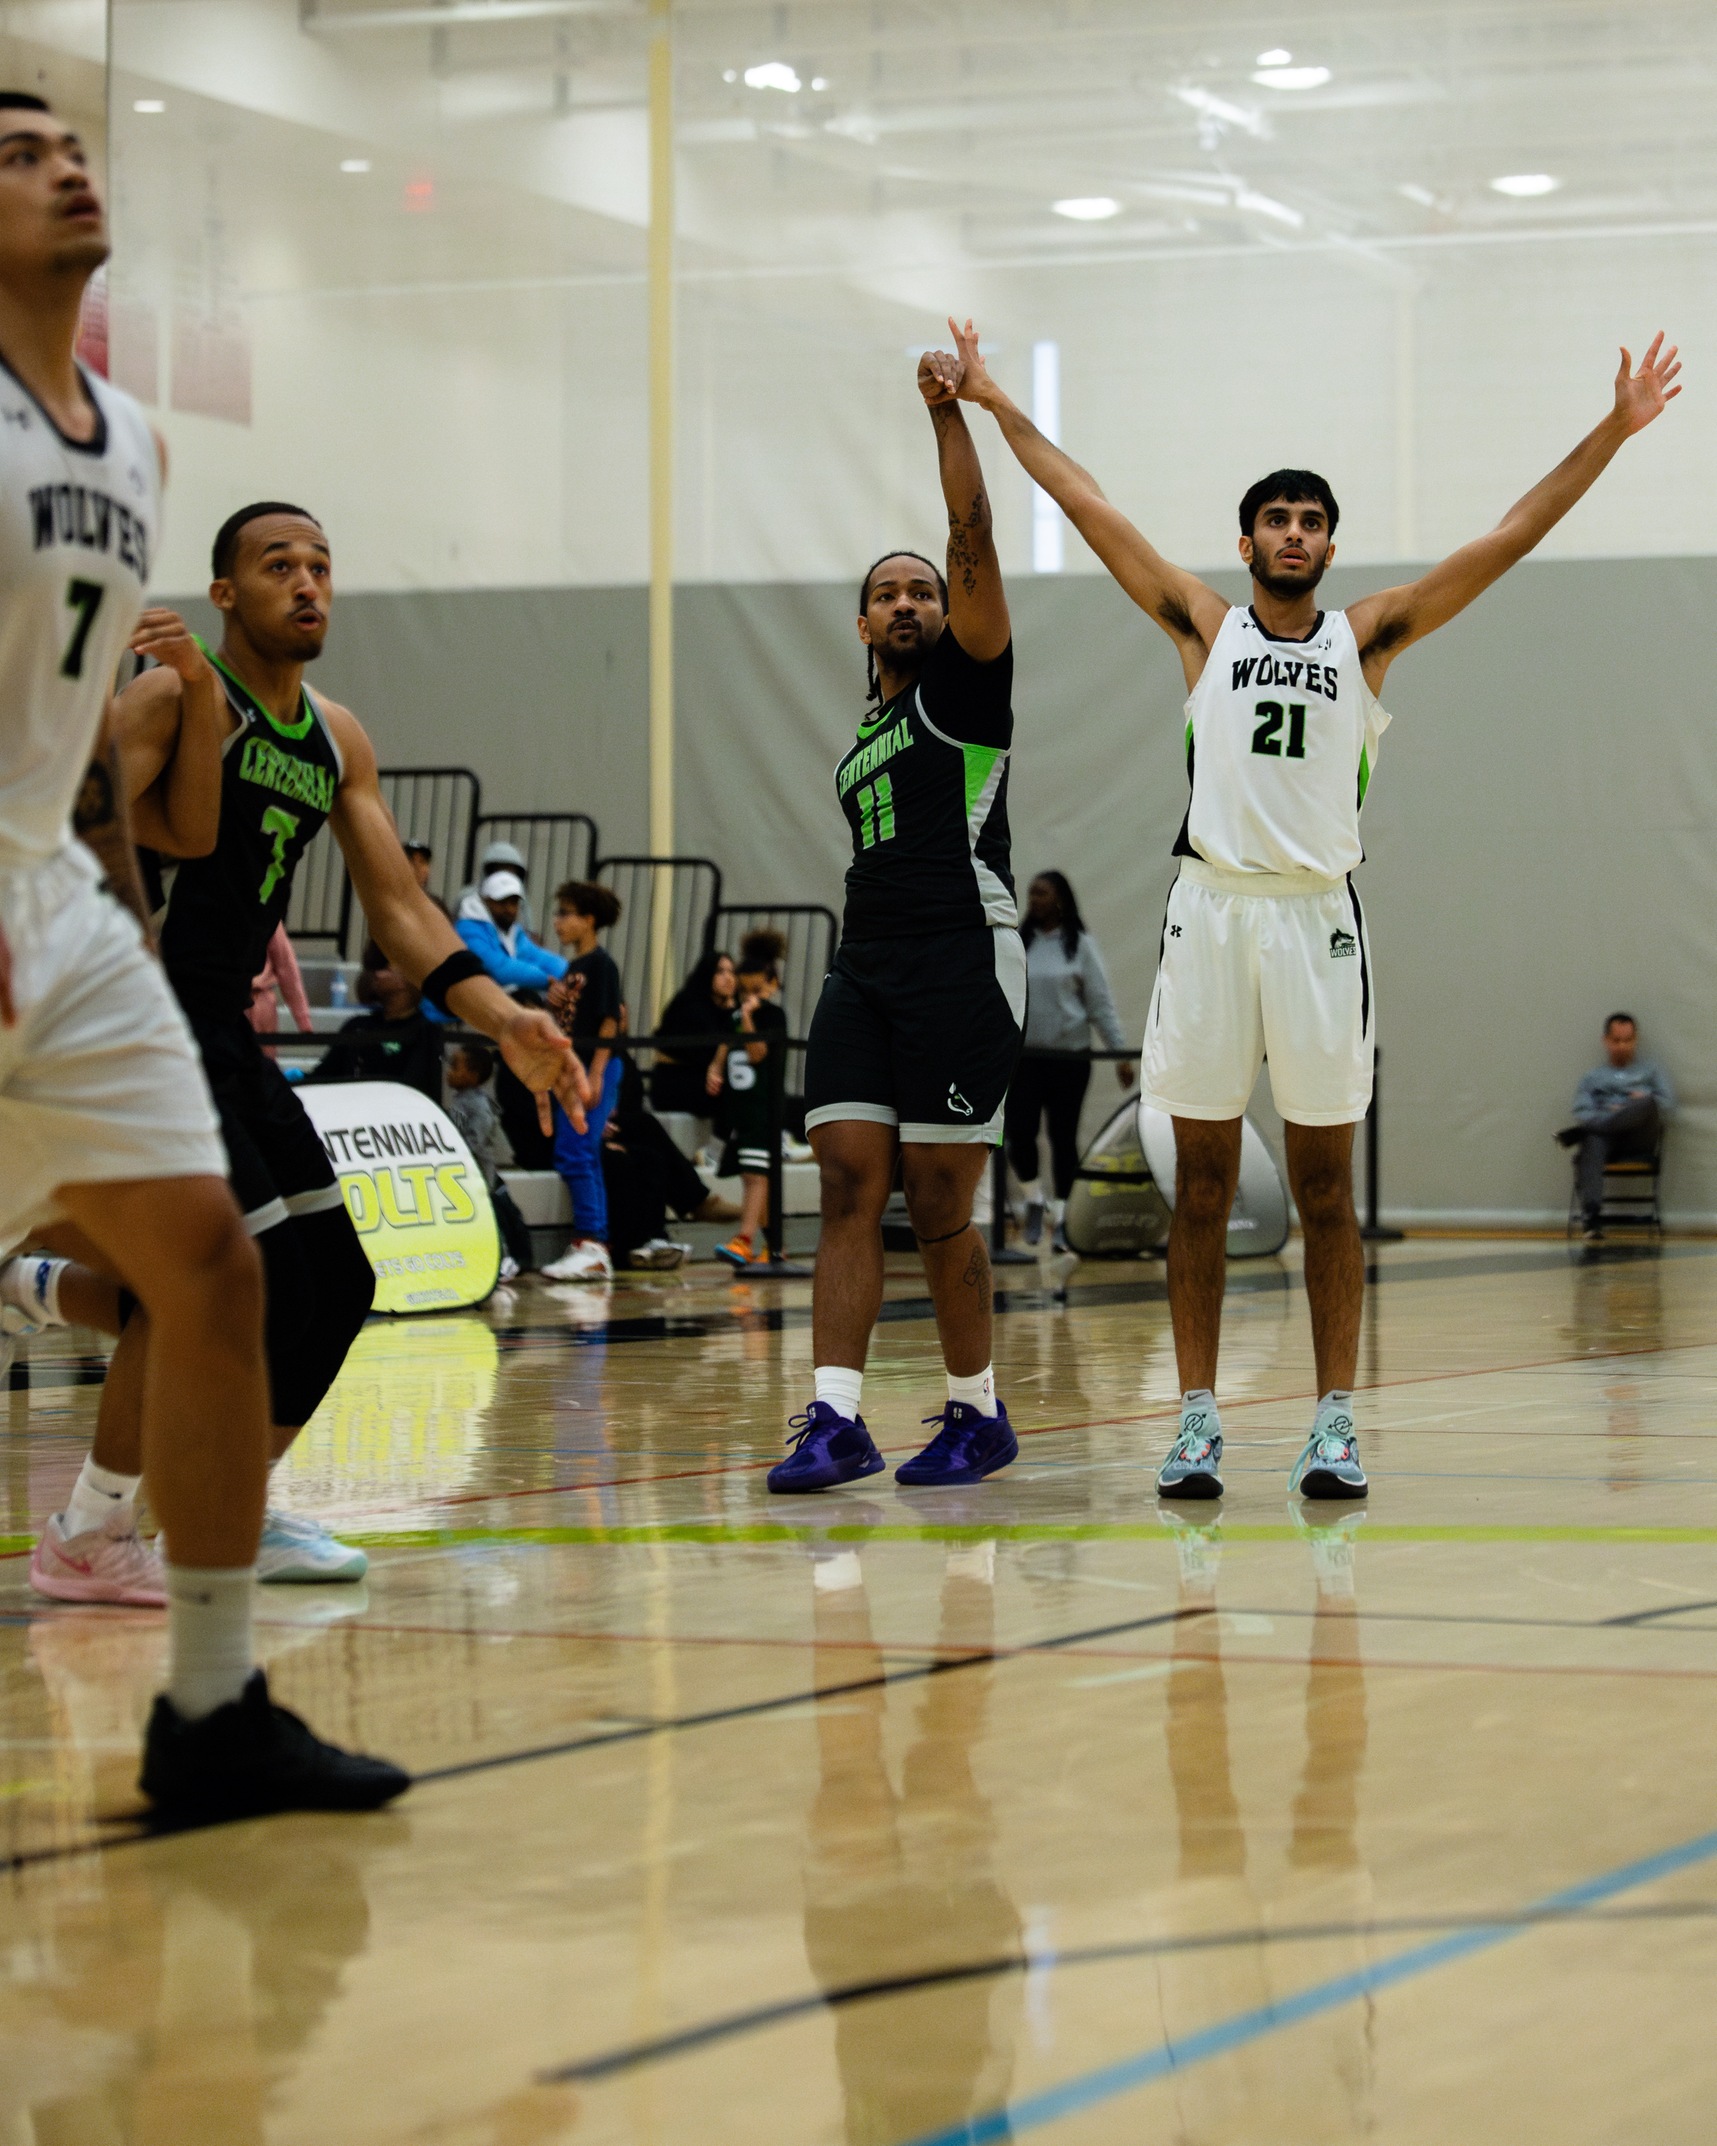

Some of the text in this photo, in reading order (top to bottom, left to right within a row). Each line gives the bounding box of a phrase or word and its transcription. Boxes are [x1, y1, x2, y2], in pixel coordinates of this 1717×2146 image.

[29, 483, 149, 586] WOLVES
[61, 576, 104, 680] 7
[1232, 654, 1338, 701] WOLVES
[1251, 700, 1306, 759] 21
[856, 772, 896, 849] 11
[259, 805, 300, 905] 7
[323, 1122, 455, 1163] NTENNIAL
[337, 1161, 475, 1234] OLTS
[374, 1258, 404, 1278] ETS
[424, 1251, 466, 1271] COLTS
